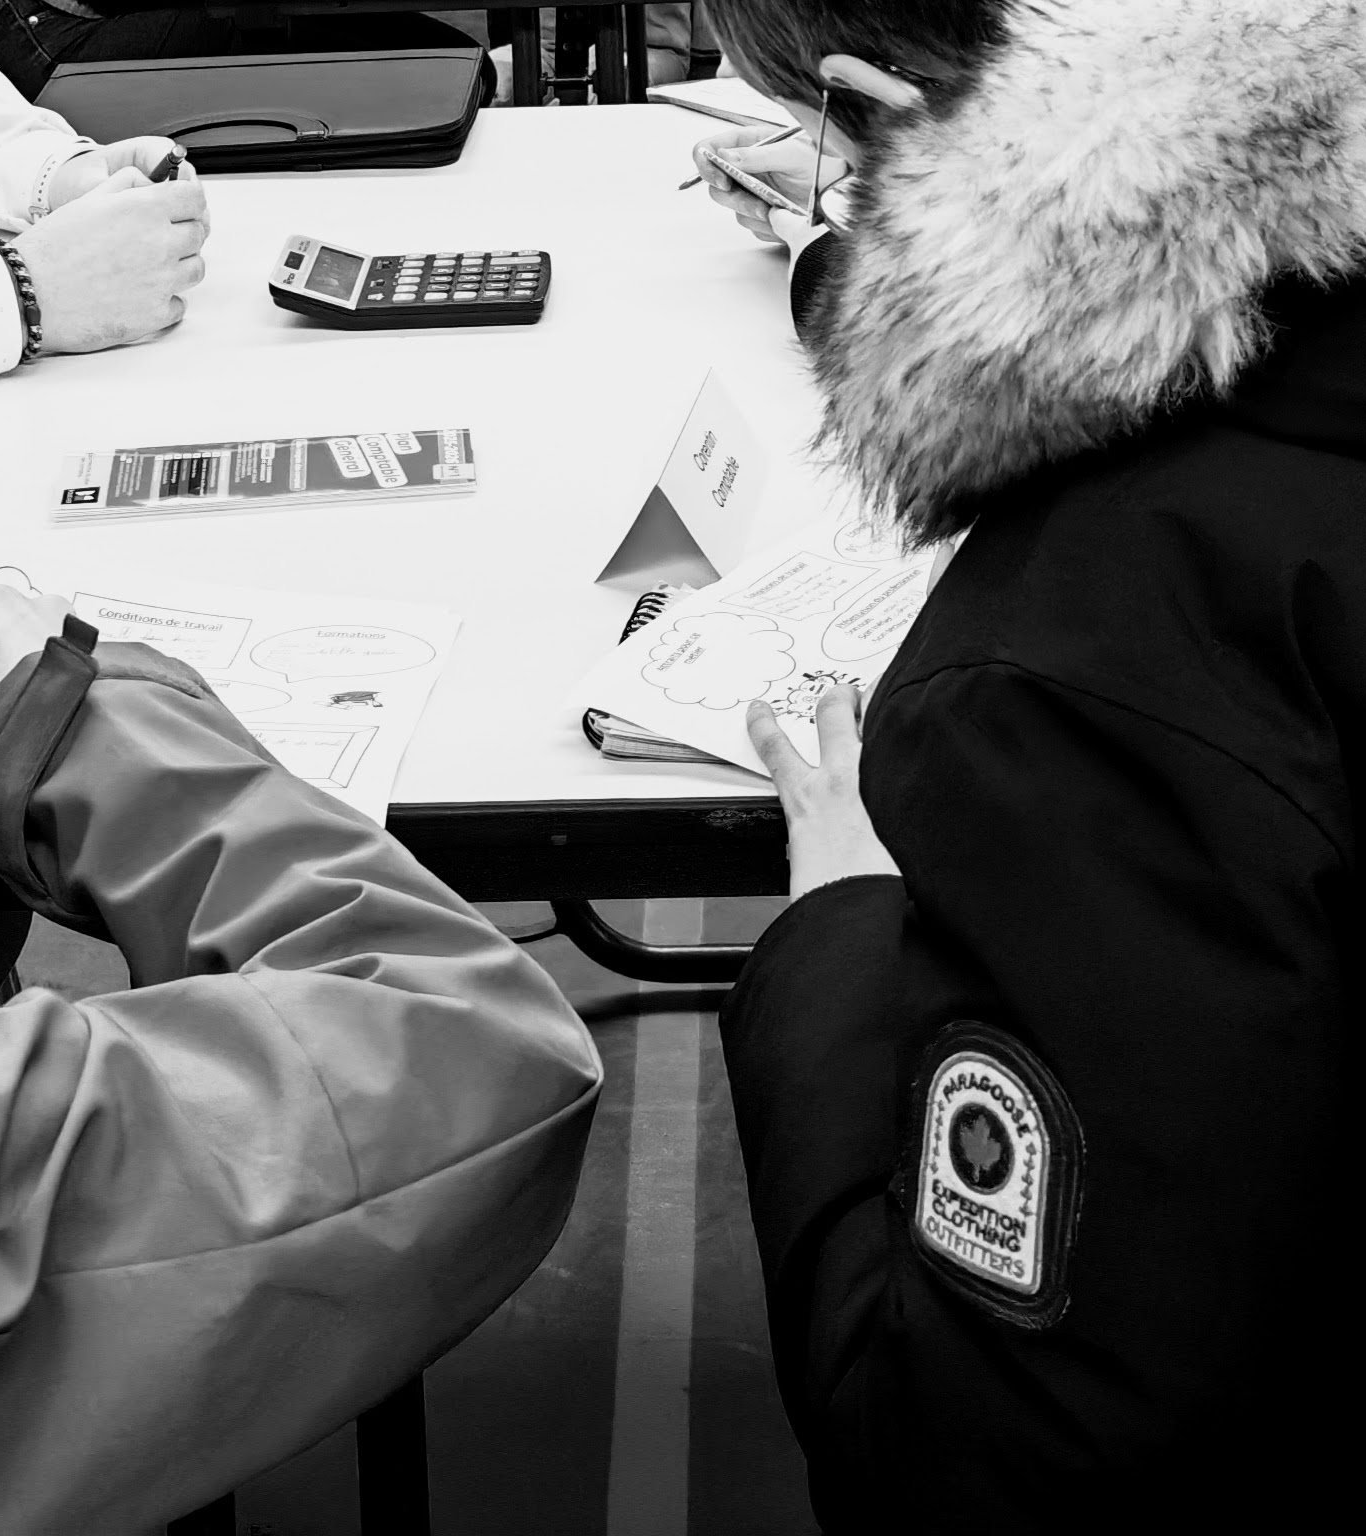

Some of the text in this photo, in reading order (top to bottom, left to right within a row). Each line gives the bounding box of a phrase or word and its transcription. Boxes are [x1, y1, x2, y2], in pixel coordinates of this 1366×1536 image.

[334, 439, 362, 474] Général
[364, 435, 399, 485] Comptable
[395, 432, 413, 453] Plan
[98, 607, 223, 632] Conditions de travail
[317, 629, 386, 640] Formations
[943, 1072, 1031, 1138] PARAGOOSE
[932, 1179, 1027, 1239] EXPEDITION
[932, 1197, 1021, 1253] CLOTHING
[926, 1215, 1025, 1279] OUTFITTERS
